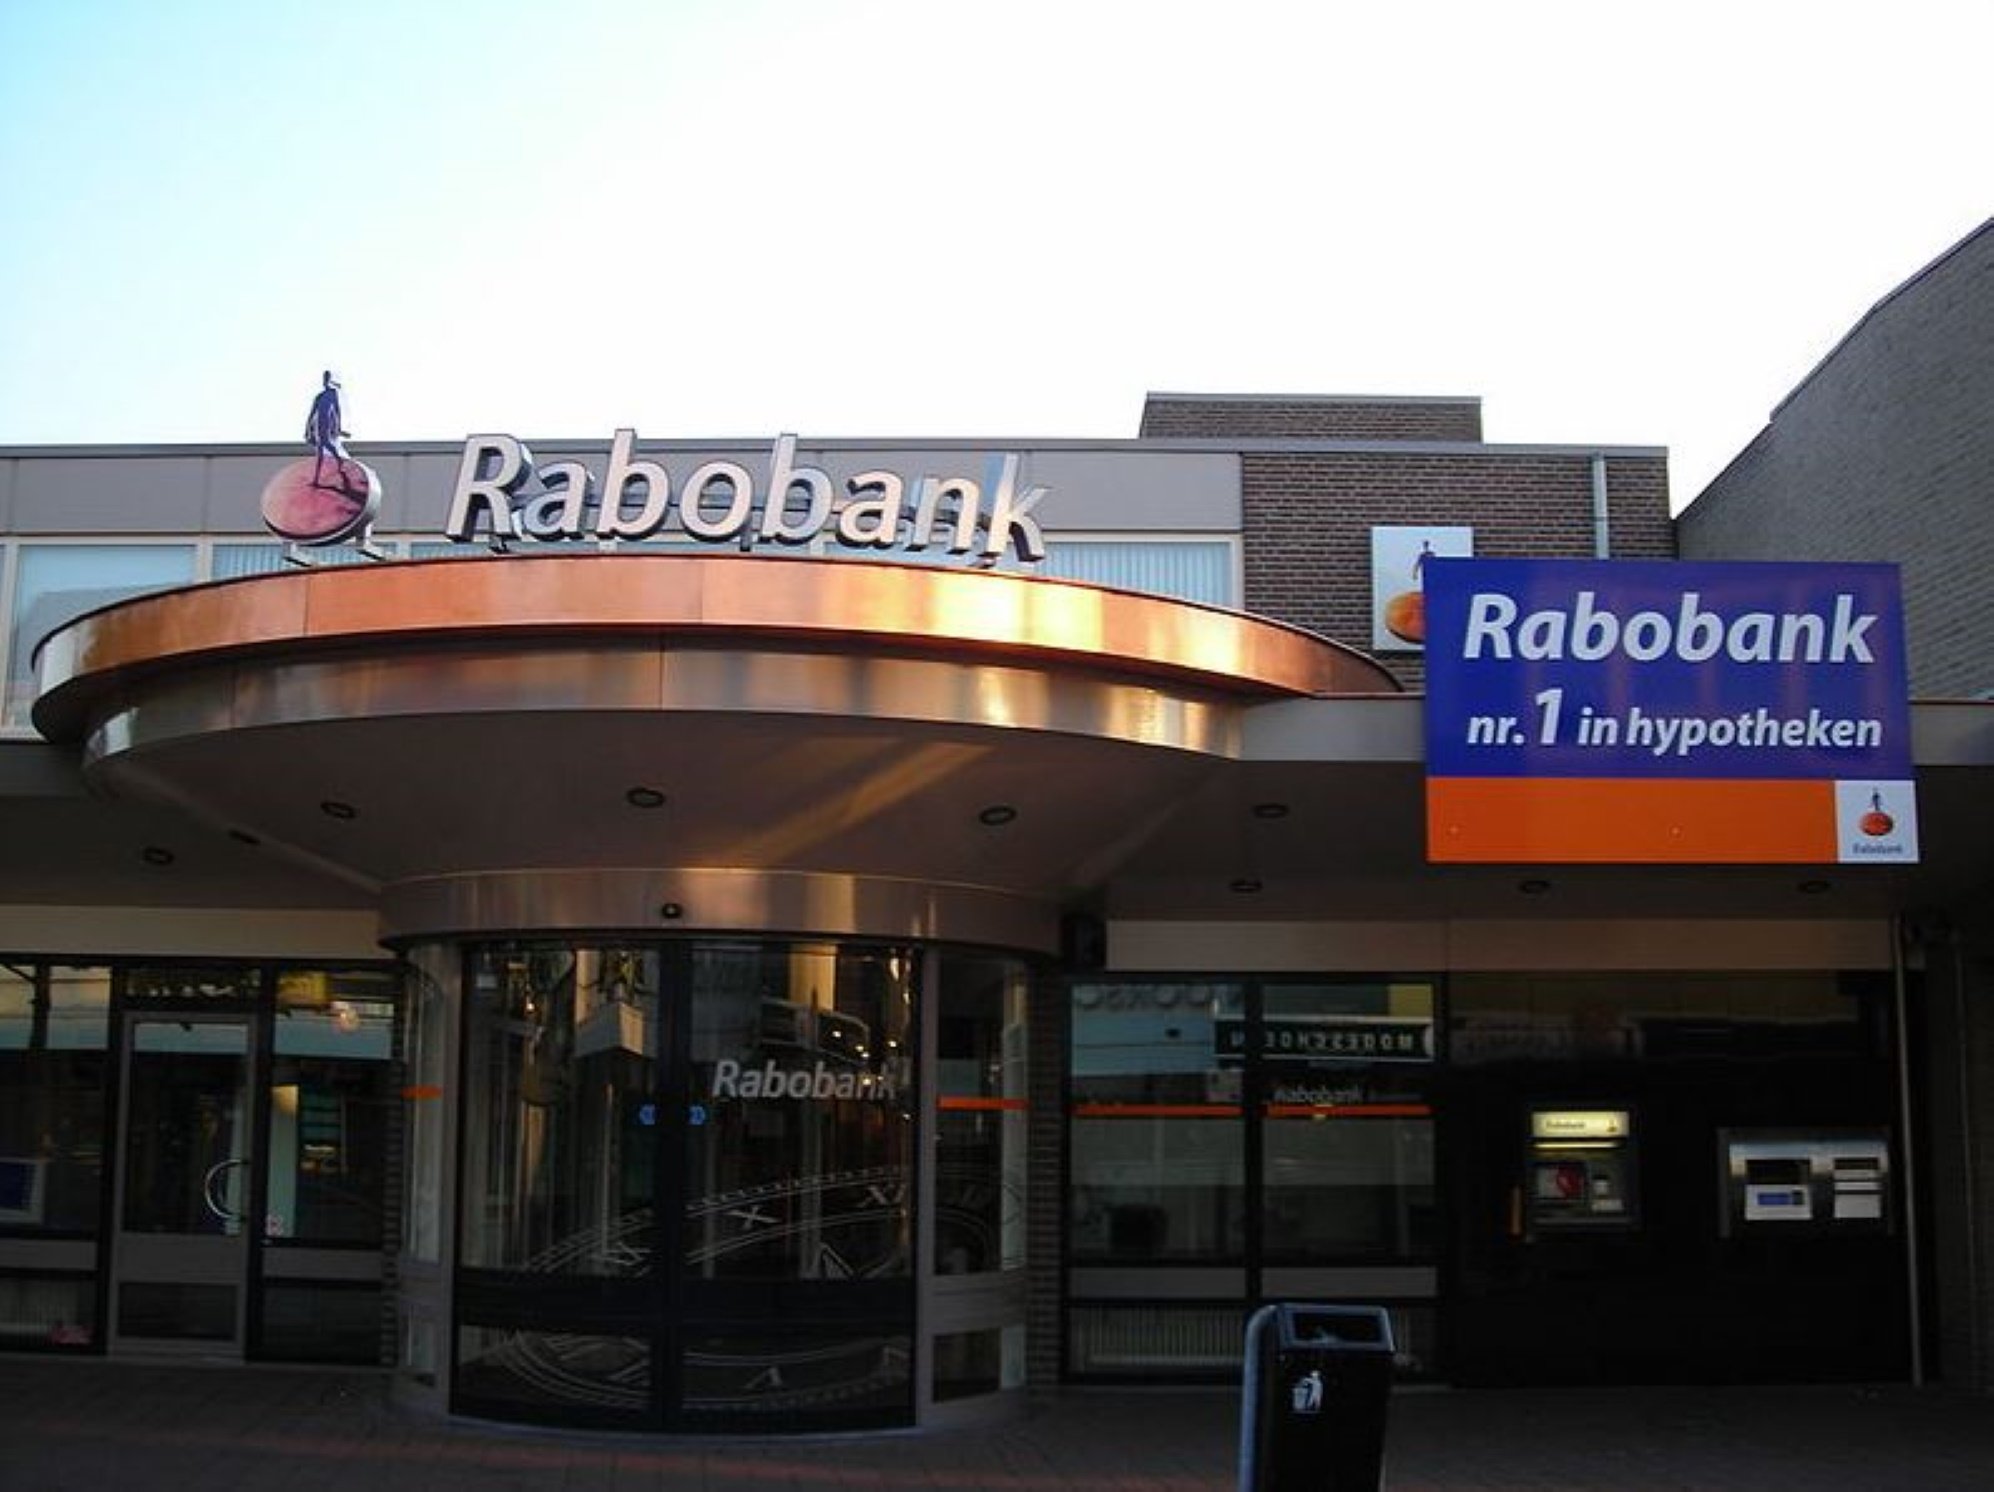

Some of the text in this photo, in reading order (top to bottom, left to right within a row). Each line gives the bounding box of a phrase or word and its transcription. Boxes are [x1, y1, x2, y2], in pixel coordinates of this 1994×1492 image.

[446, 428, 1047, 562] Rabobank
[1463, 591, 1878, 664] Rabobank
[1467, 689, 1881, 756] nr. 1 in hypotheken
[712, 1058, 896, 1101] Rabobank
